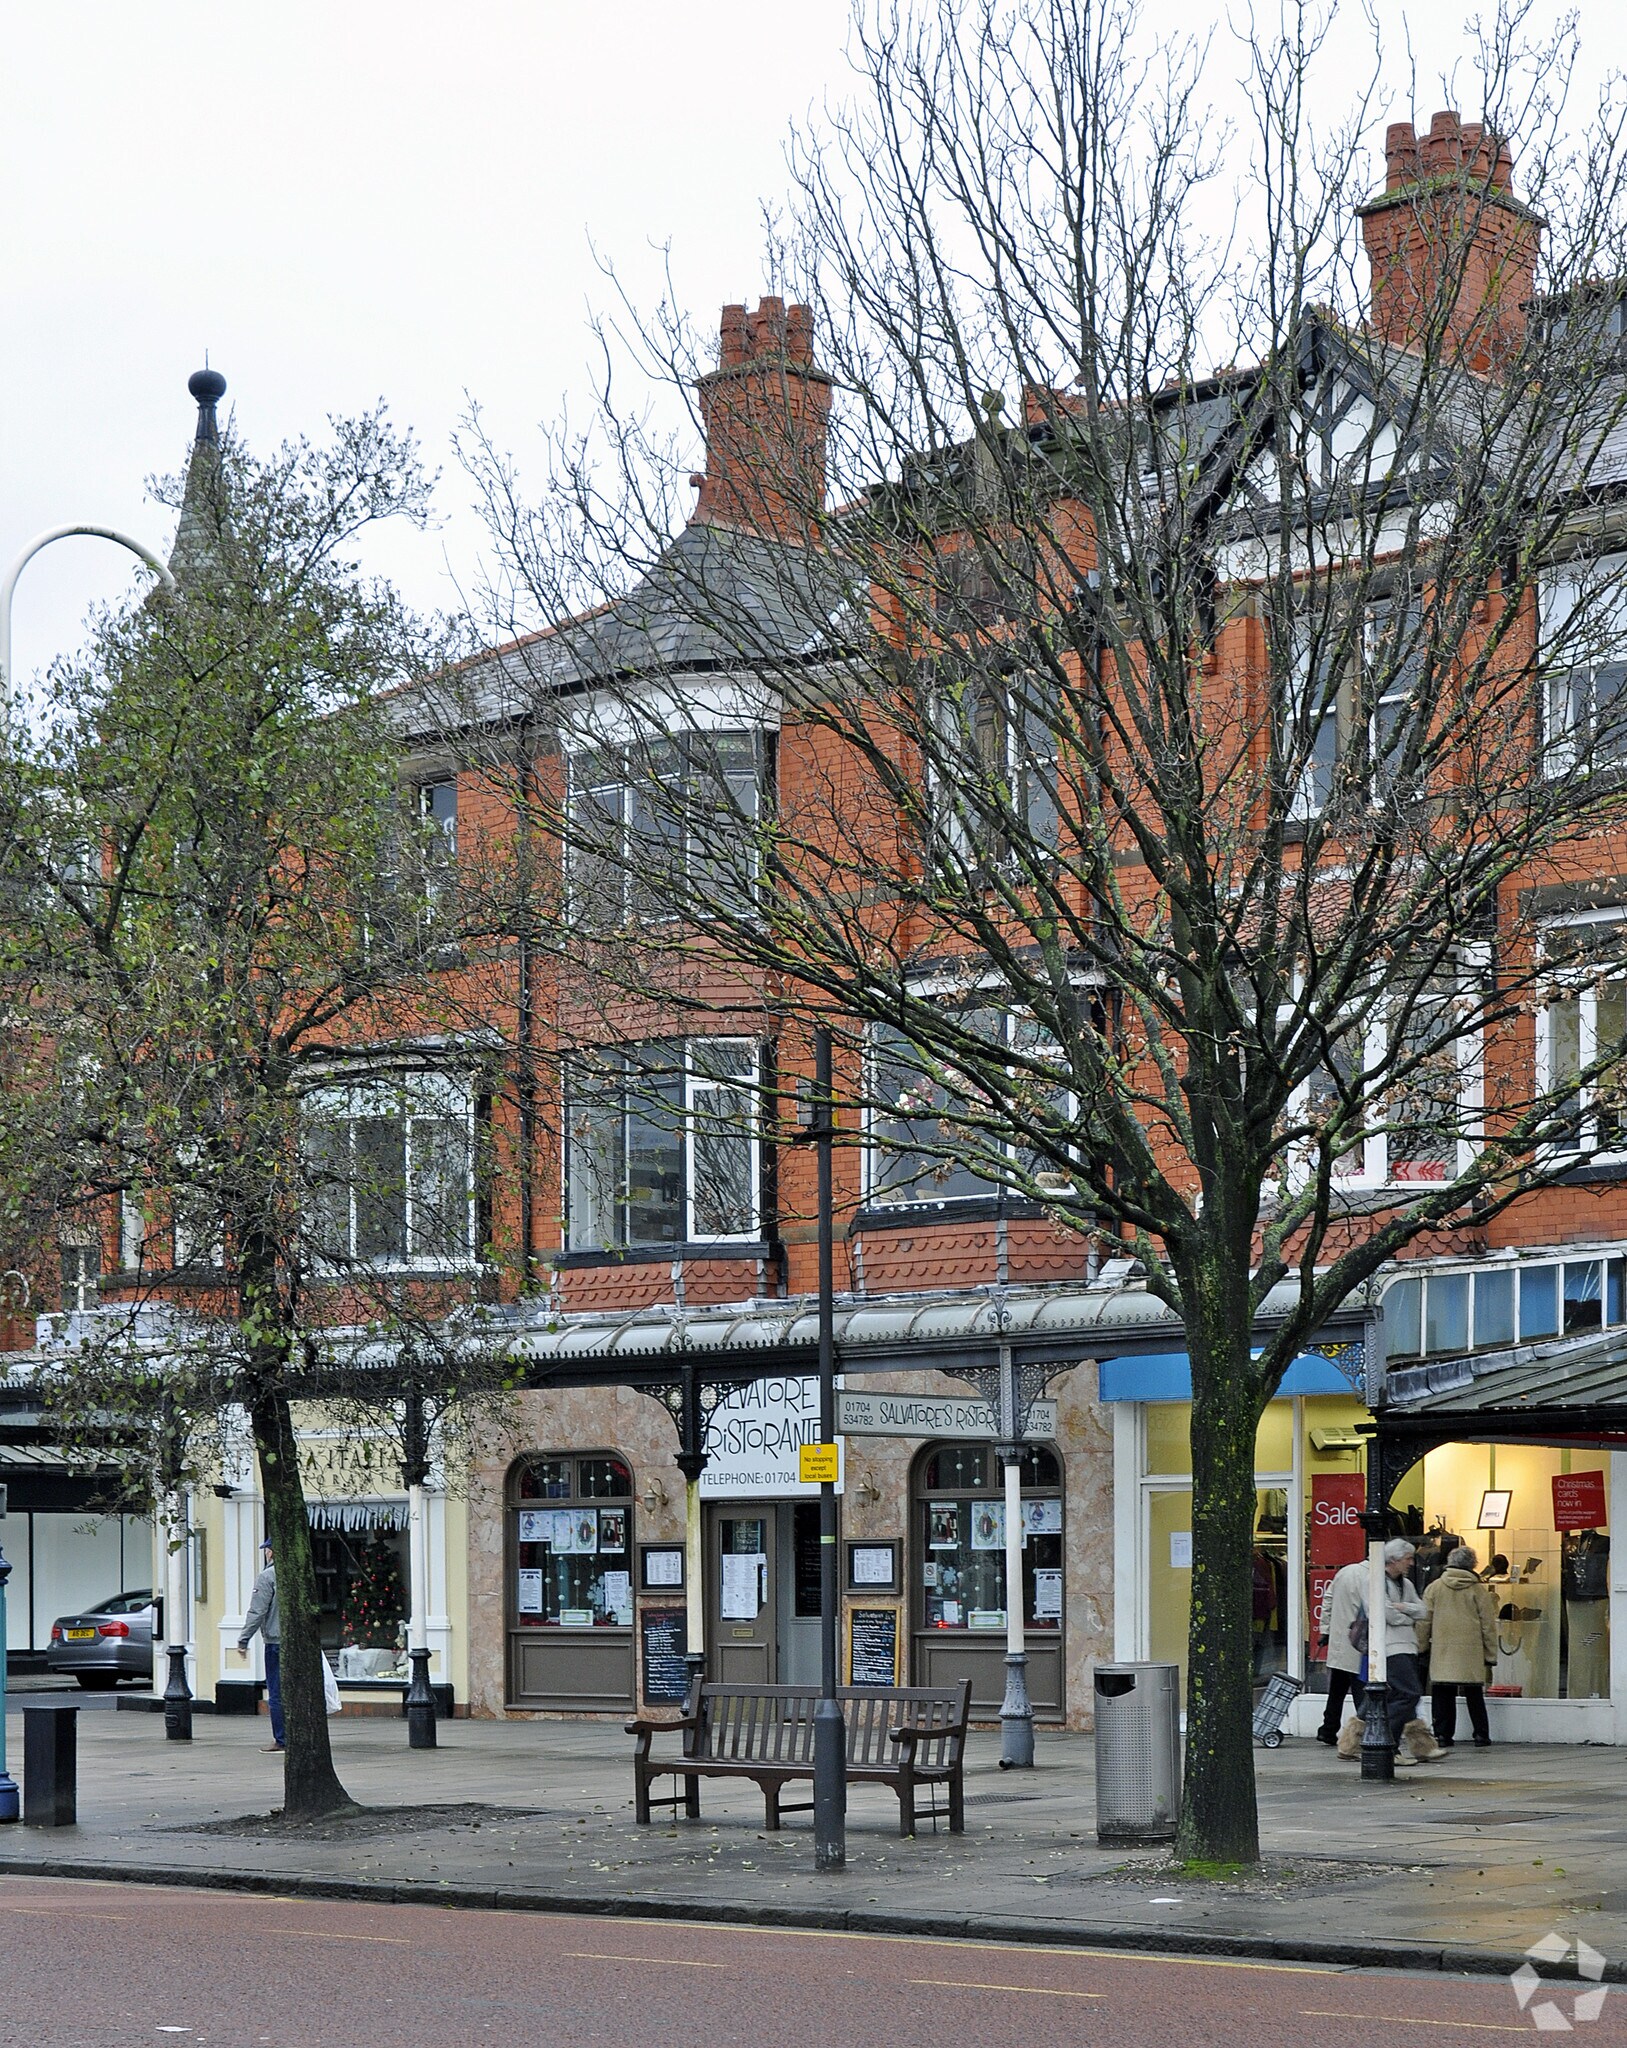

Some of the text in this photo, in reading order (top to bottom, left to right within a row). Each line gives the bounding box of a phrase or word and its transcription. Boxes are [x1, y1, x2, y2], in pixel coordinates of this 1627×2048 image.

[845, 1401, 871, 1412] 01704
[843, 1414, 874, 1426] 534782
[955, 1405, 997, 1431] RiSTOR
[765, 1472, 796, 1482] 01704
[1557, 1479, 1595, 1488] Christmas
[1315, 1501, 1359, 1525] Sale
